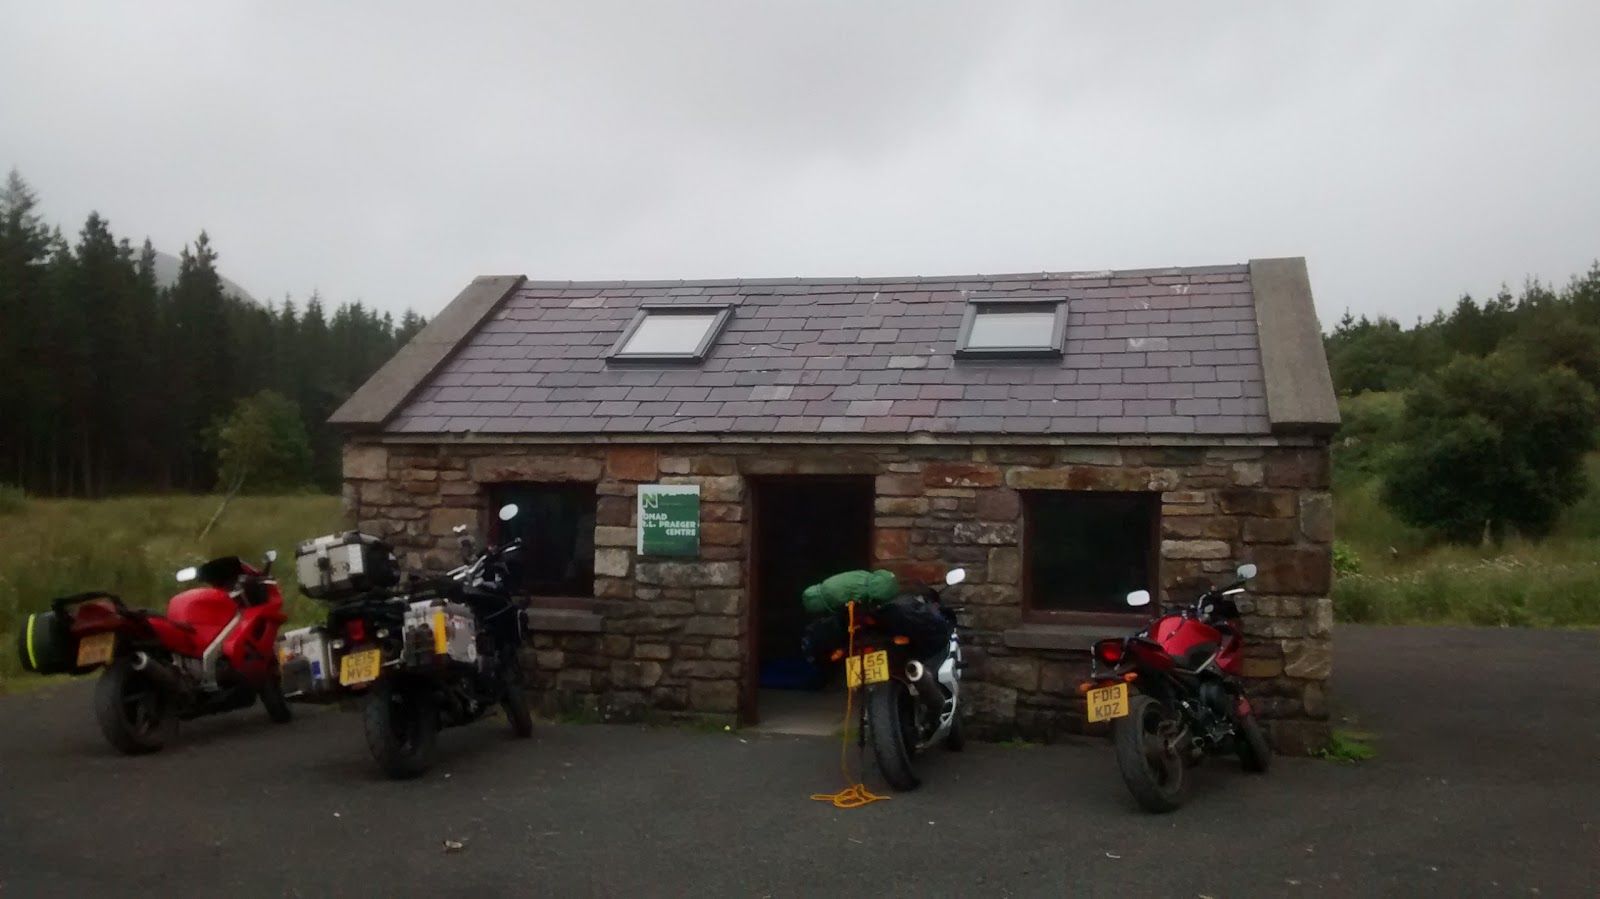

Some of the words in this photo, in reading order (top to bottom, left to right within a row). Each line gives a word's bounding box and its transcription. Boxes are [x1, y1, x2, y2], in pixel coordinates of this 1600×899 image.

[665, 528, 696, 536] CENTRE
[848, 654, 885, 671] Y55
[1093, 687, 1121, 704] FD13
[1095, 703, 1121, 718] KDZ
